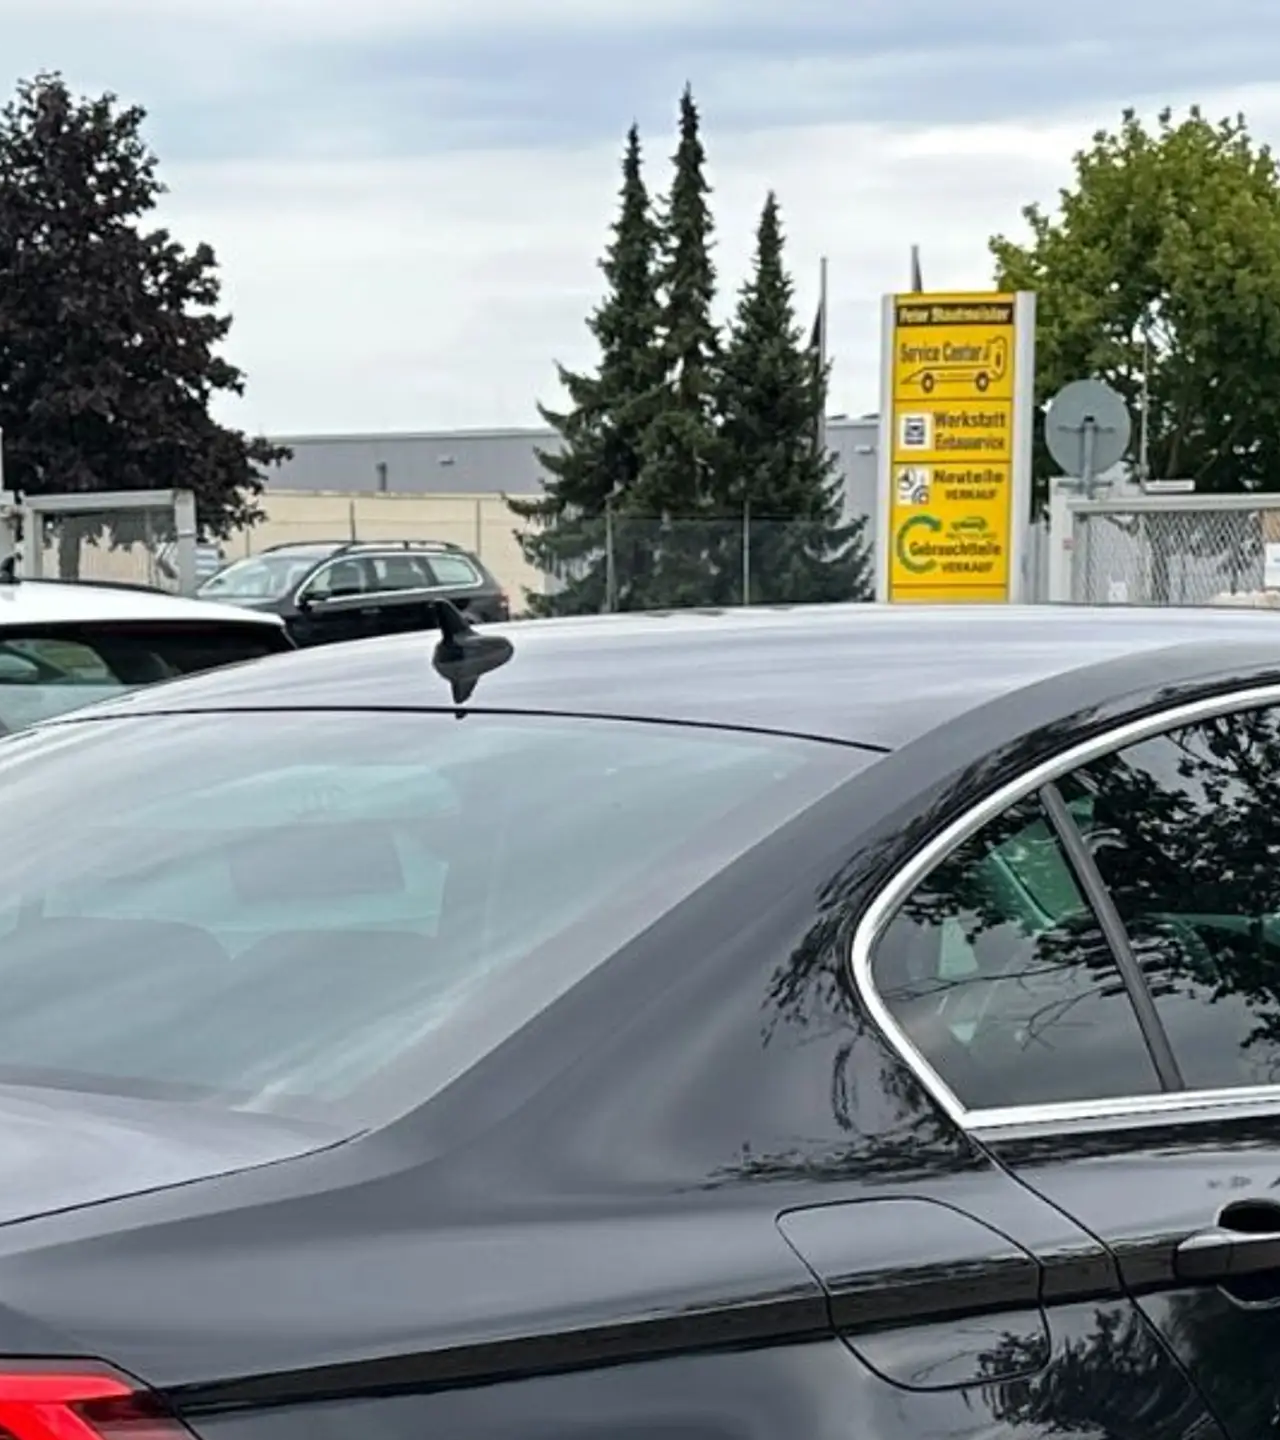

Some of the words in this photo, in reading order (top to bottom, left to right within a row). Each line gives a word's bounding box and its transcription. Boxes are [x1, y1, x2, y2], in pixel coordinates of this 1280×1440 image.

[901, 342, 939, 363] Service
[943, 341, 982, 361] Center
[934, 411, 1005, 428] Werkstatt
[934, 469, 1004, 484] Neuteile
[945, 488, 996, 500] VERKAUF
[941, 561, 994, 574] VERKAUF
